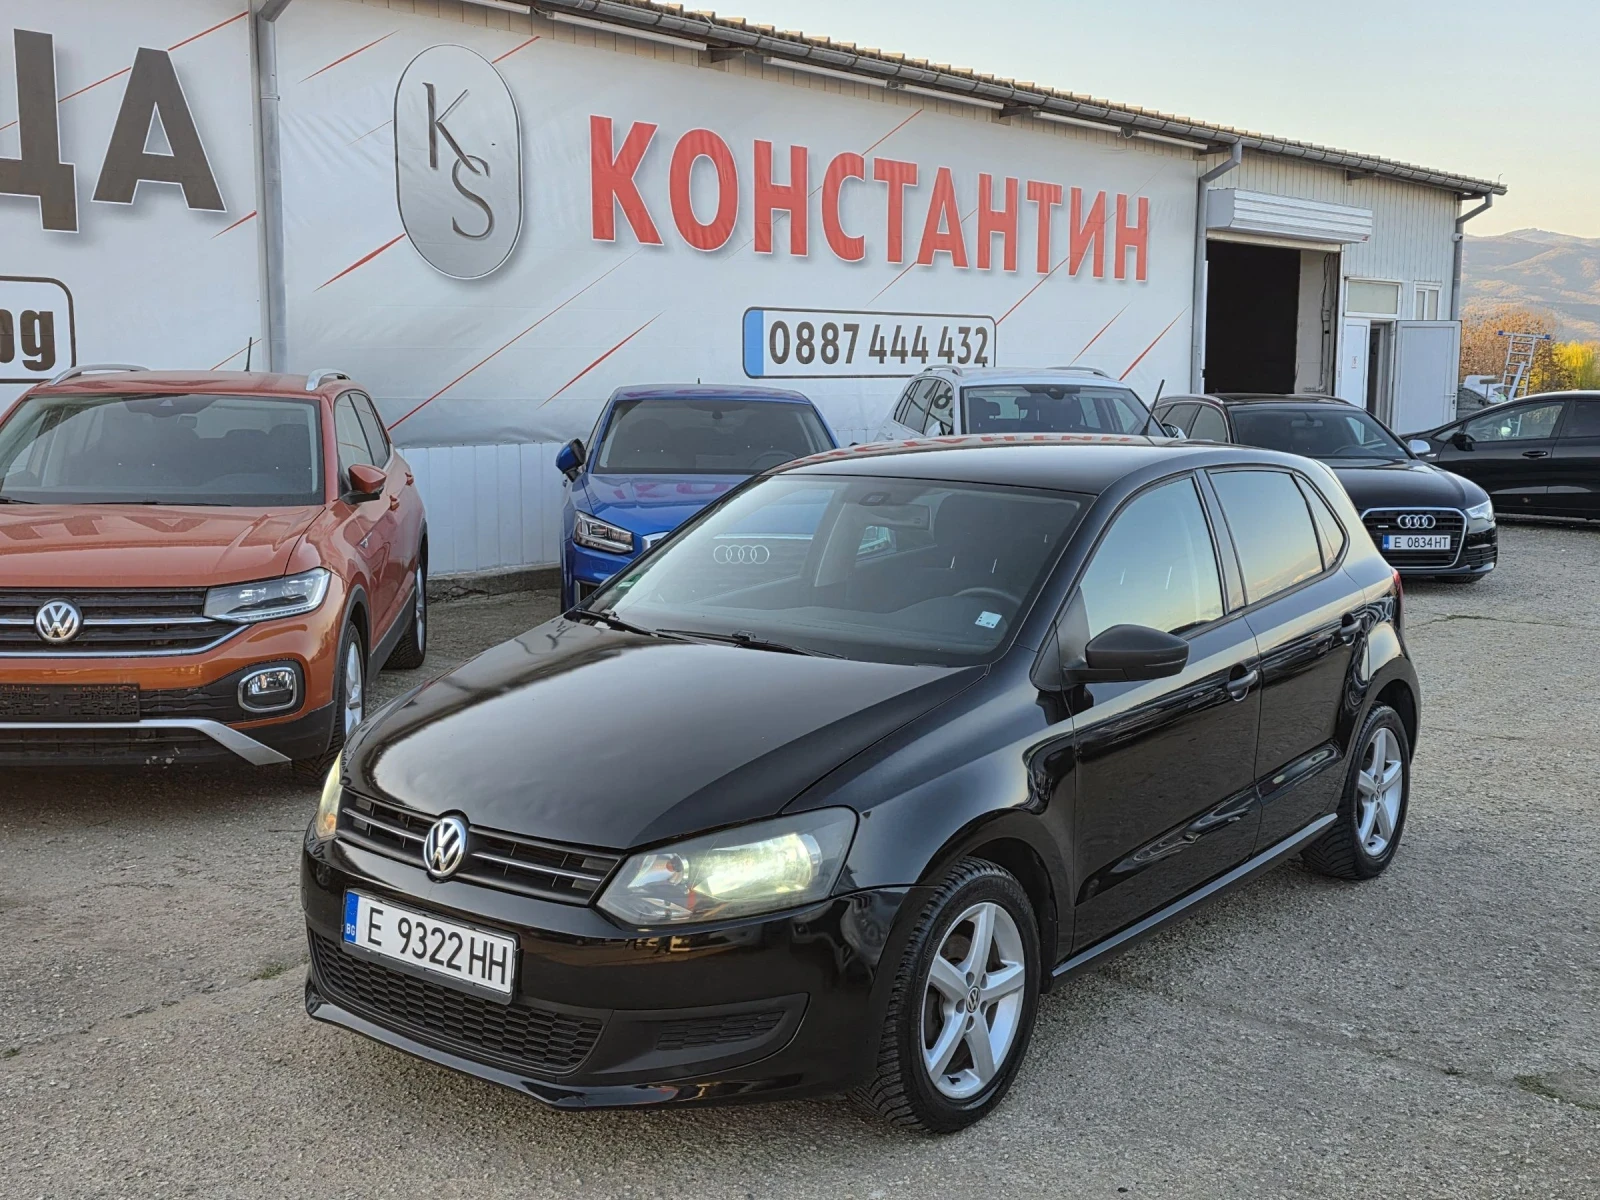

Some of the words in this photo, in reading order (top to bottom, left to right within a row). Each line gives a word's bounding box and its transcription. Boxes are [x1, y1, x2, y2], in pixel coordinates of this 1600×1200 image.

[589, 113, 1149, 282] КОНСТАНТИН
[769, 320, 860, 365] 0887
[868, 324, 929, 364] 444
[937, 326, 989, 364] 432
[1394, 536, 1402, 548] E
[346, 923, 356, 936] BG
[367, 906, 385, 947] E
